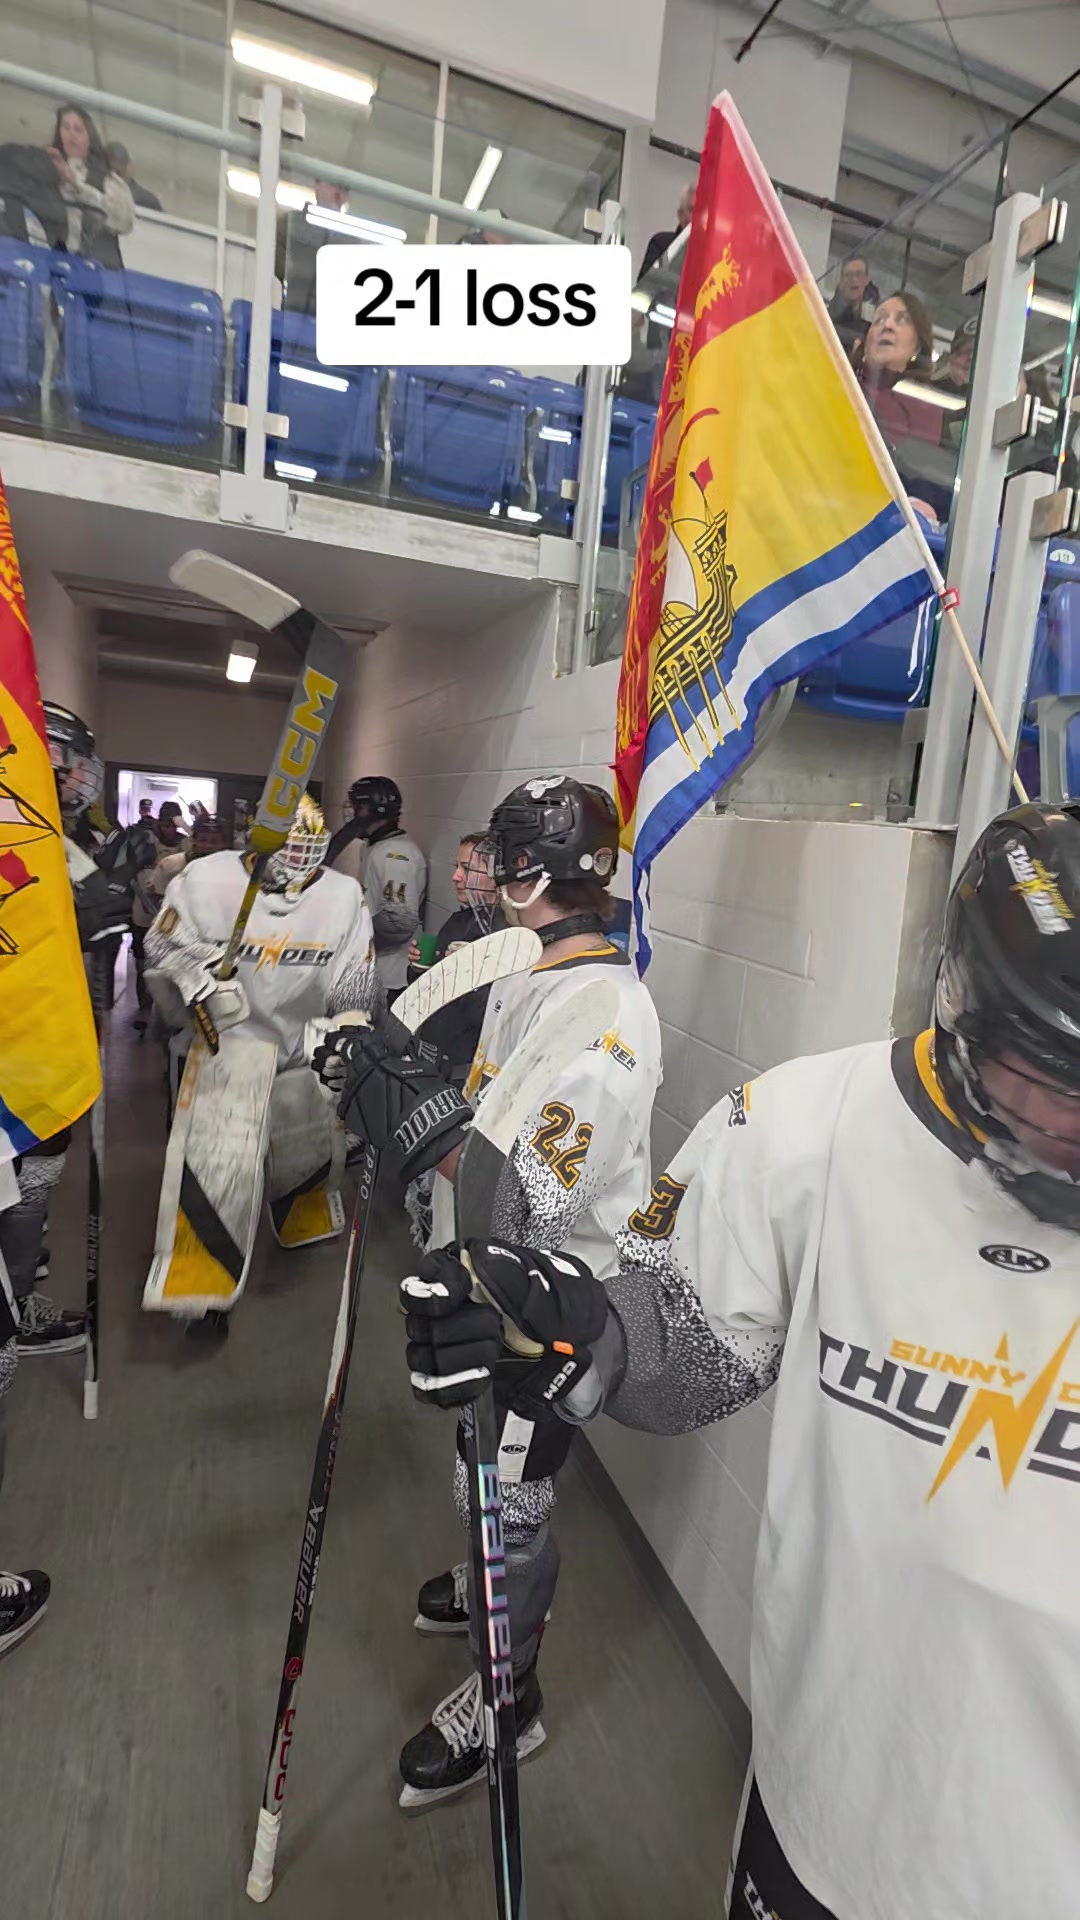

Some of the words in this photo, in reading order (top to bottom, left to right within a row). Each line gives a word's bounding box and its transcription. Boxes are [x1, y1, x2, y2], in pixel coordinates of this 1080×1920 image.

[267, 666, 339, 818] CCM
[383, 879, 407, 904] 44
[530, 1100, 594, 1191] 22
[543, 1360, 578, 1402] CCM
[889, 1338, 1026, 1387] SUNNY
[819, 1320, 1080, 1504] THUND
